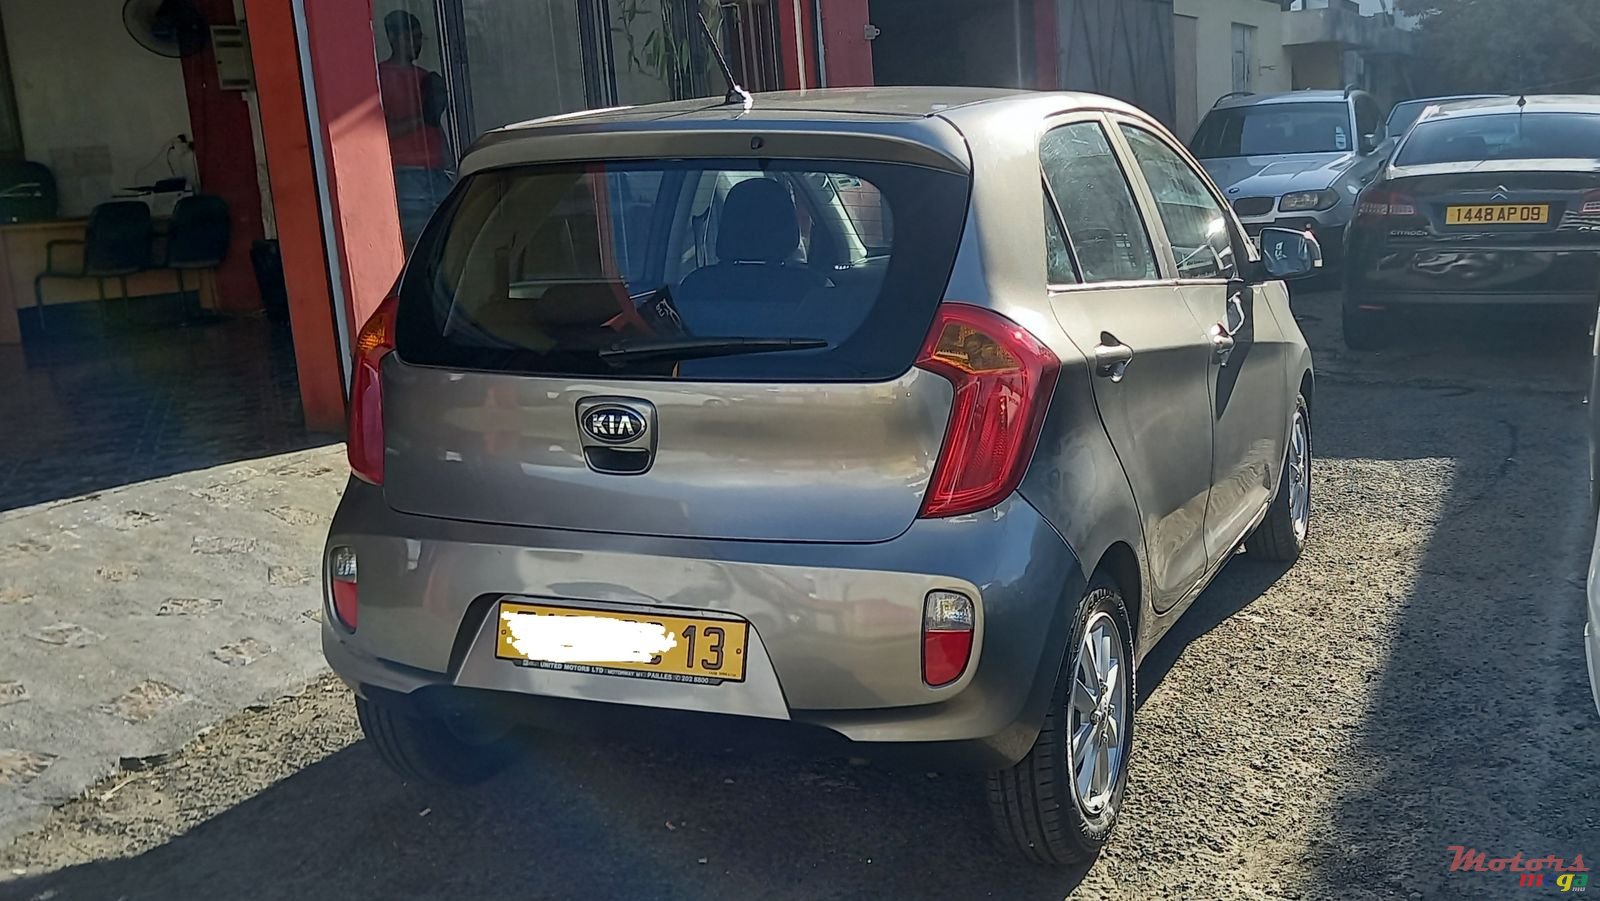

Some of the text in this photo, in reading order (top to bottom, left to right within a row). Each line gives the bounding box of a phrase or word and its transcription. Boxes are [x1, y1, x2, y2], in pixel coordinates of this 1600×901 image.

[1456, 206, 1541, 222] 1448 AP 09
[592, 414, 635, 434] KIA
[682, 625, 725, 670] 13
[564, 664, 590, 672] MOTORS
[647, 672, 672, 680] PAILLES
